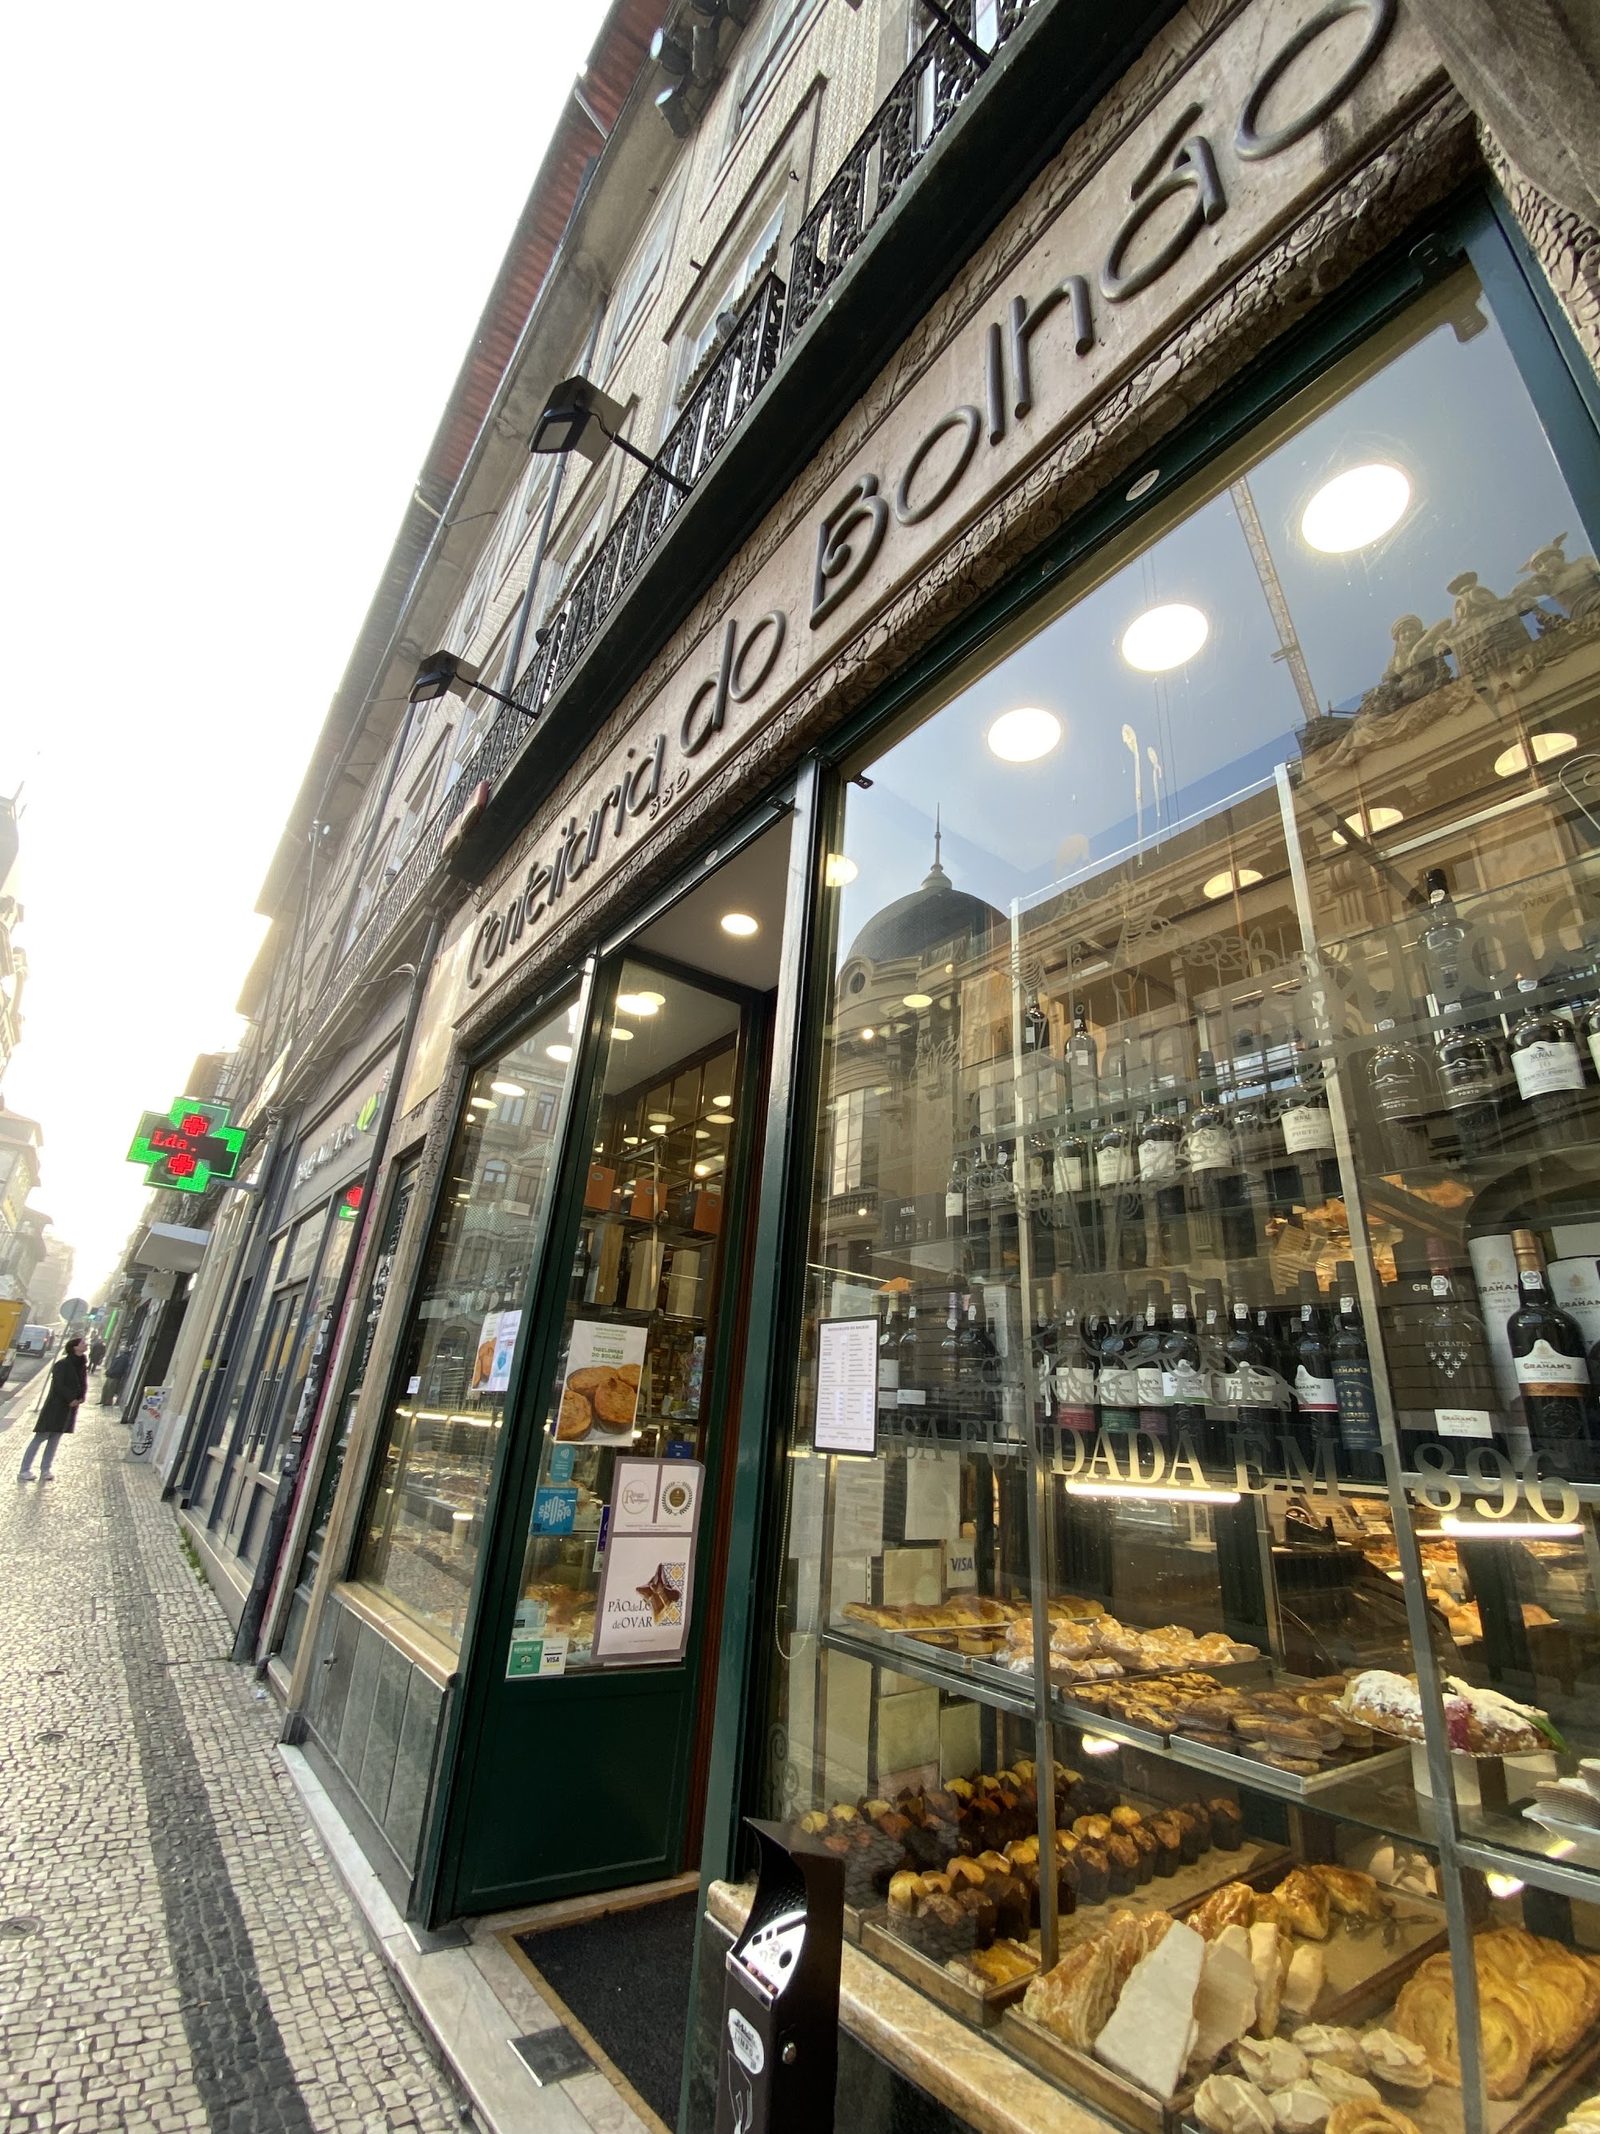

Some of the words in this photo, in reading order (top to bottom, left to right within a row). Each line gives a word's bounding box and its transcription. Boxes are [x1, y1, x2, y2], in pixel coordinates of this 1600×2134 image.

[466, 733, 665, 989] Confeitaria
[680, 608, 788, 757] do
[810, 0, 1398, 630] Bolhão
[1530, 1050, 1556, 1060] NOVAL
[152, 1128, 197, 1151] Lda.
[877, 1413, 945, 1462] ASA
[958, 1418, 1211, 1488] FUNDADA
[1229, 1433, 1344, 1500] EM
[1374, 1442, 1580, 1523] 1896
[951, 1558, 973, 1571] VISA
[608, 1599, 631, 1612] PÃO
[621, 1617, 652, 1628] OVAR
